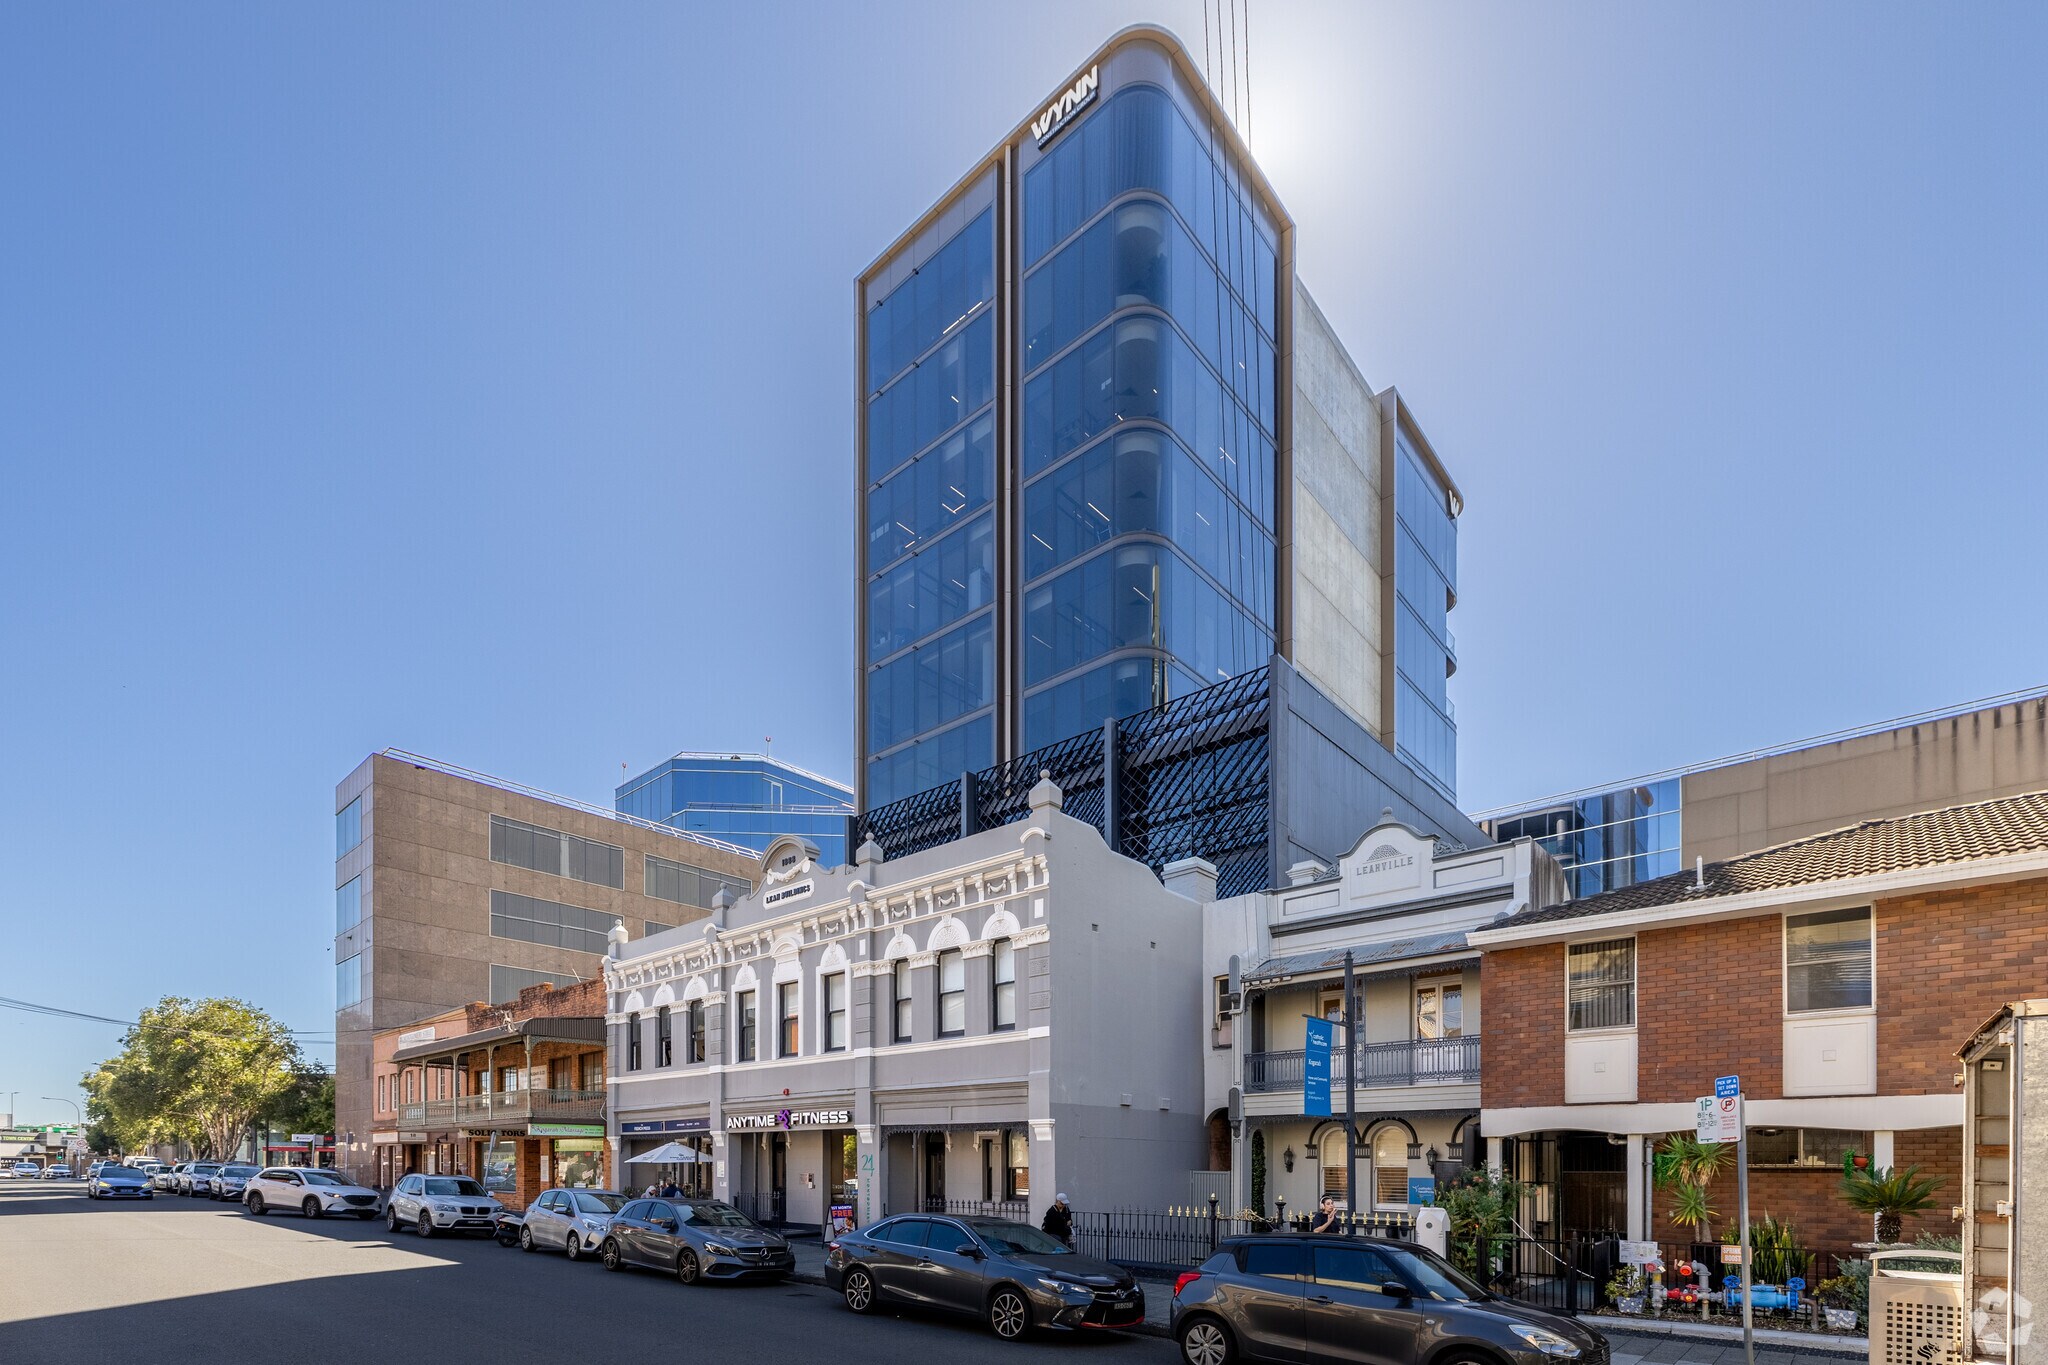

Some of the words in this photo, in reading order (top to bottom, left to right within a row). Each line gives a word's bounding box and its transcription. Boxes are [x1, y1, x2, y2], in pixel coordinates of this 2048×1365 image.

[1031, 64, 1098, 140] WYNN
[1038, 109, 1077, 146] CONSTRUCTION
[1076, 88, 1097, 111] GROUP
[1356, 856, 1413, 876] LEAHVILLE
[781, 885, 810, 899] BUILDINGS
[727, 1114, 775, 1128] ANYTIME
[790, 1111, 849, 1125] FITNESS
[832, 1209, 853, 1217] FREE
